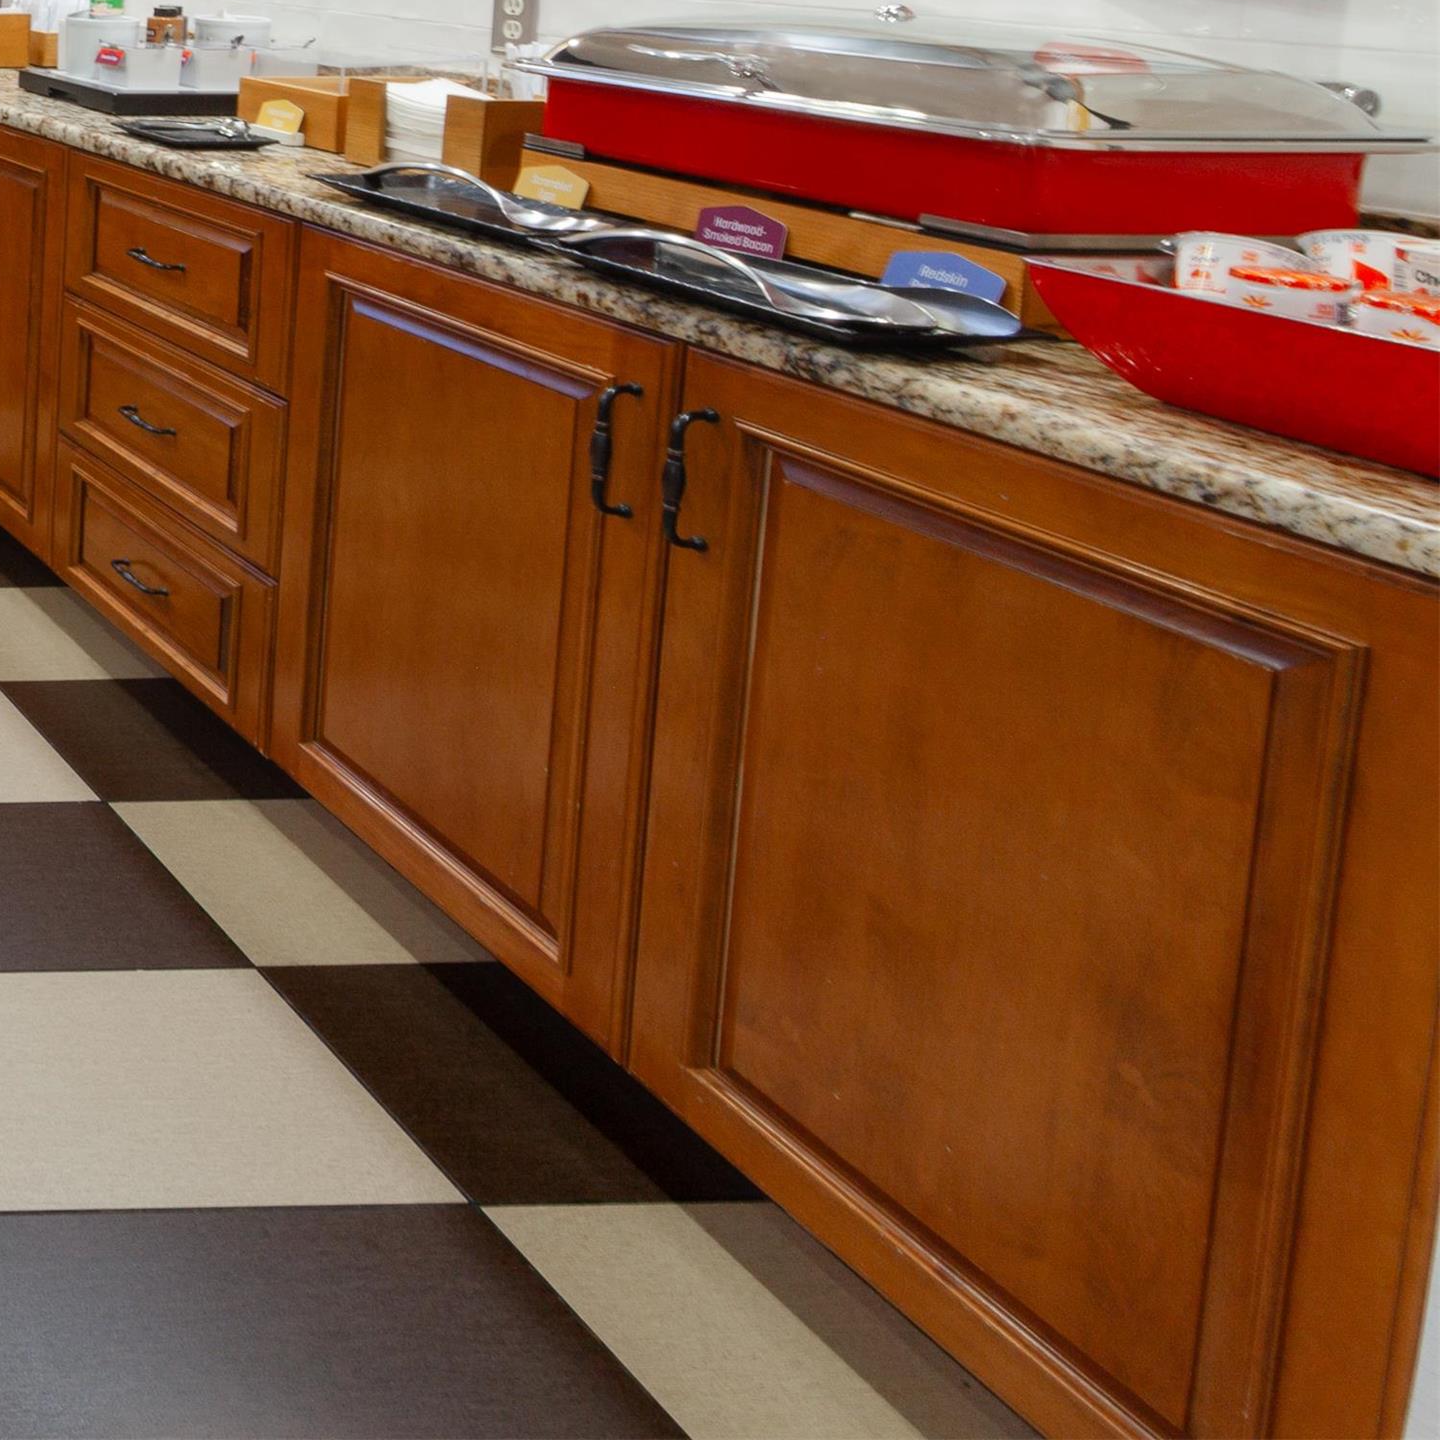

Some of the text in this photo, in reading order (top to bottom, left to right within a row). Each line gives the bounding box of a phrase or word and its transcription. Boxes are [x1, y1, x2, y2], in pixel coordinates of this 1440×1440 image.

[714, 216, 767, 237] Hardwood-
[703, 227, 774, 253] Smoked Bacon
[919, 263, 968, 288] Redskin
